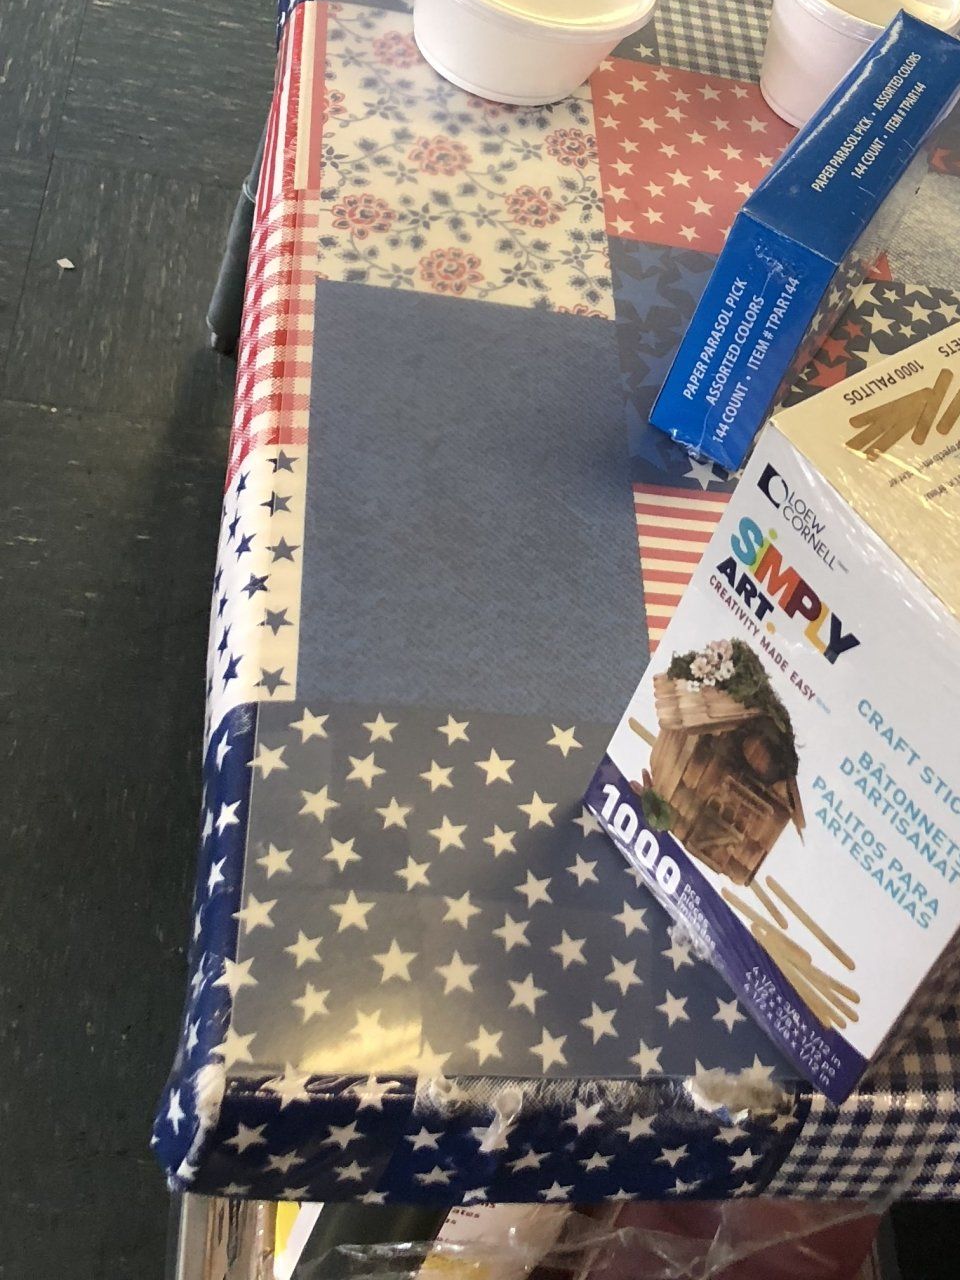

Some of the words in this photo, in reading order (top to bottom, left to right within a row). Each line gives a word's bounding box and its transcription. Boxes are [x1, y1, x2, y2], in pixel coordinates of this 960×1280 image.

[811, 164, 838, 194] PAPER
[829, 133, 863, 170] PARASOL
[853, 116, 874, 137] PICK
[872, 74, 904, 112] ASSORTED
[897, 51, 922, 79] COLORS
[851, 163, 869, 180] 144
[860, 137, 887, 167] COUNT
[883, 113, 903, 135] ITEM
[899, 81, 927, 112] TPAR144
[763, 329, 775, 340] #
[766, 276, 800, 331] TPAR144
[683, 361, 709, 401] PAPER
[700, 308, 734, 363] PARASOL
[725, 276, 748, 310] PICK
[705, 343, 742, 407] ASSORTED
[734, 294, 765, 347] COLORS
[746, 338, 771, 371] ITEM
[894, 359, 925, 381] 1000
[722, 381, 750, 424] COUNT
[843, 373, 898, 406] PALITOS
[712, 421, 730, 444] 144
[783, 505, 836, 571] CORNELL
[786, 492, 826, 535] LOEW
[709, 574, 760, 637] CREATIVITY
[759, 638, 789, 672] MADE
[789, 671, 816, 703] EASY
[857, 698, 921, 767] CRAFT
[600, 783, 682, 895] 1000
[812, 775, 888, 861] PALITOS
[887, 857, 940, 917] PARA
[815, 807, 934, 930] ARTESANIAS
